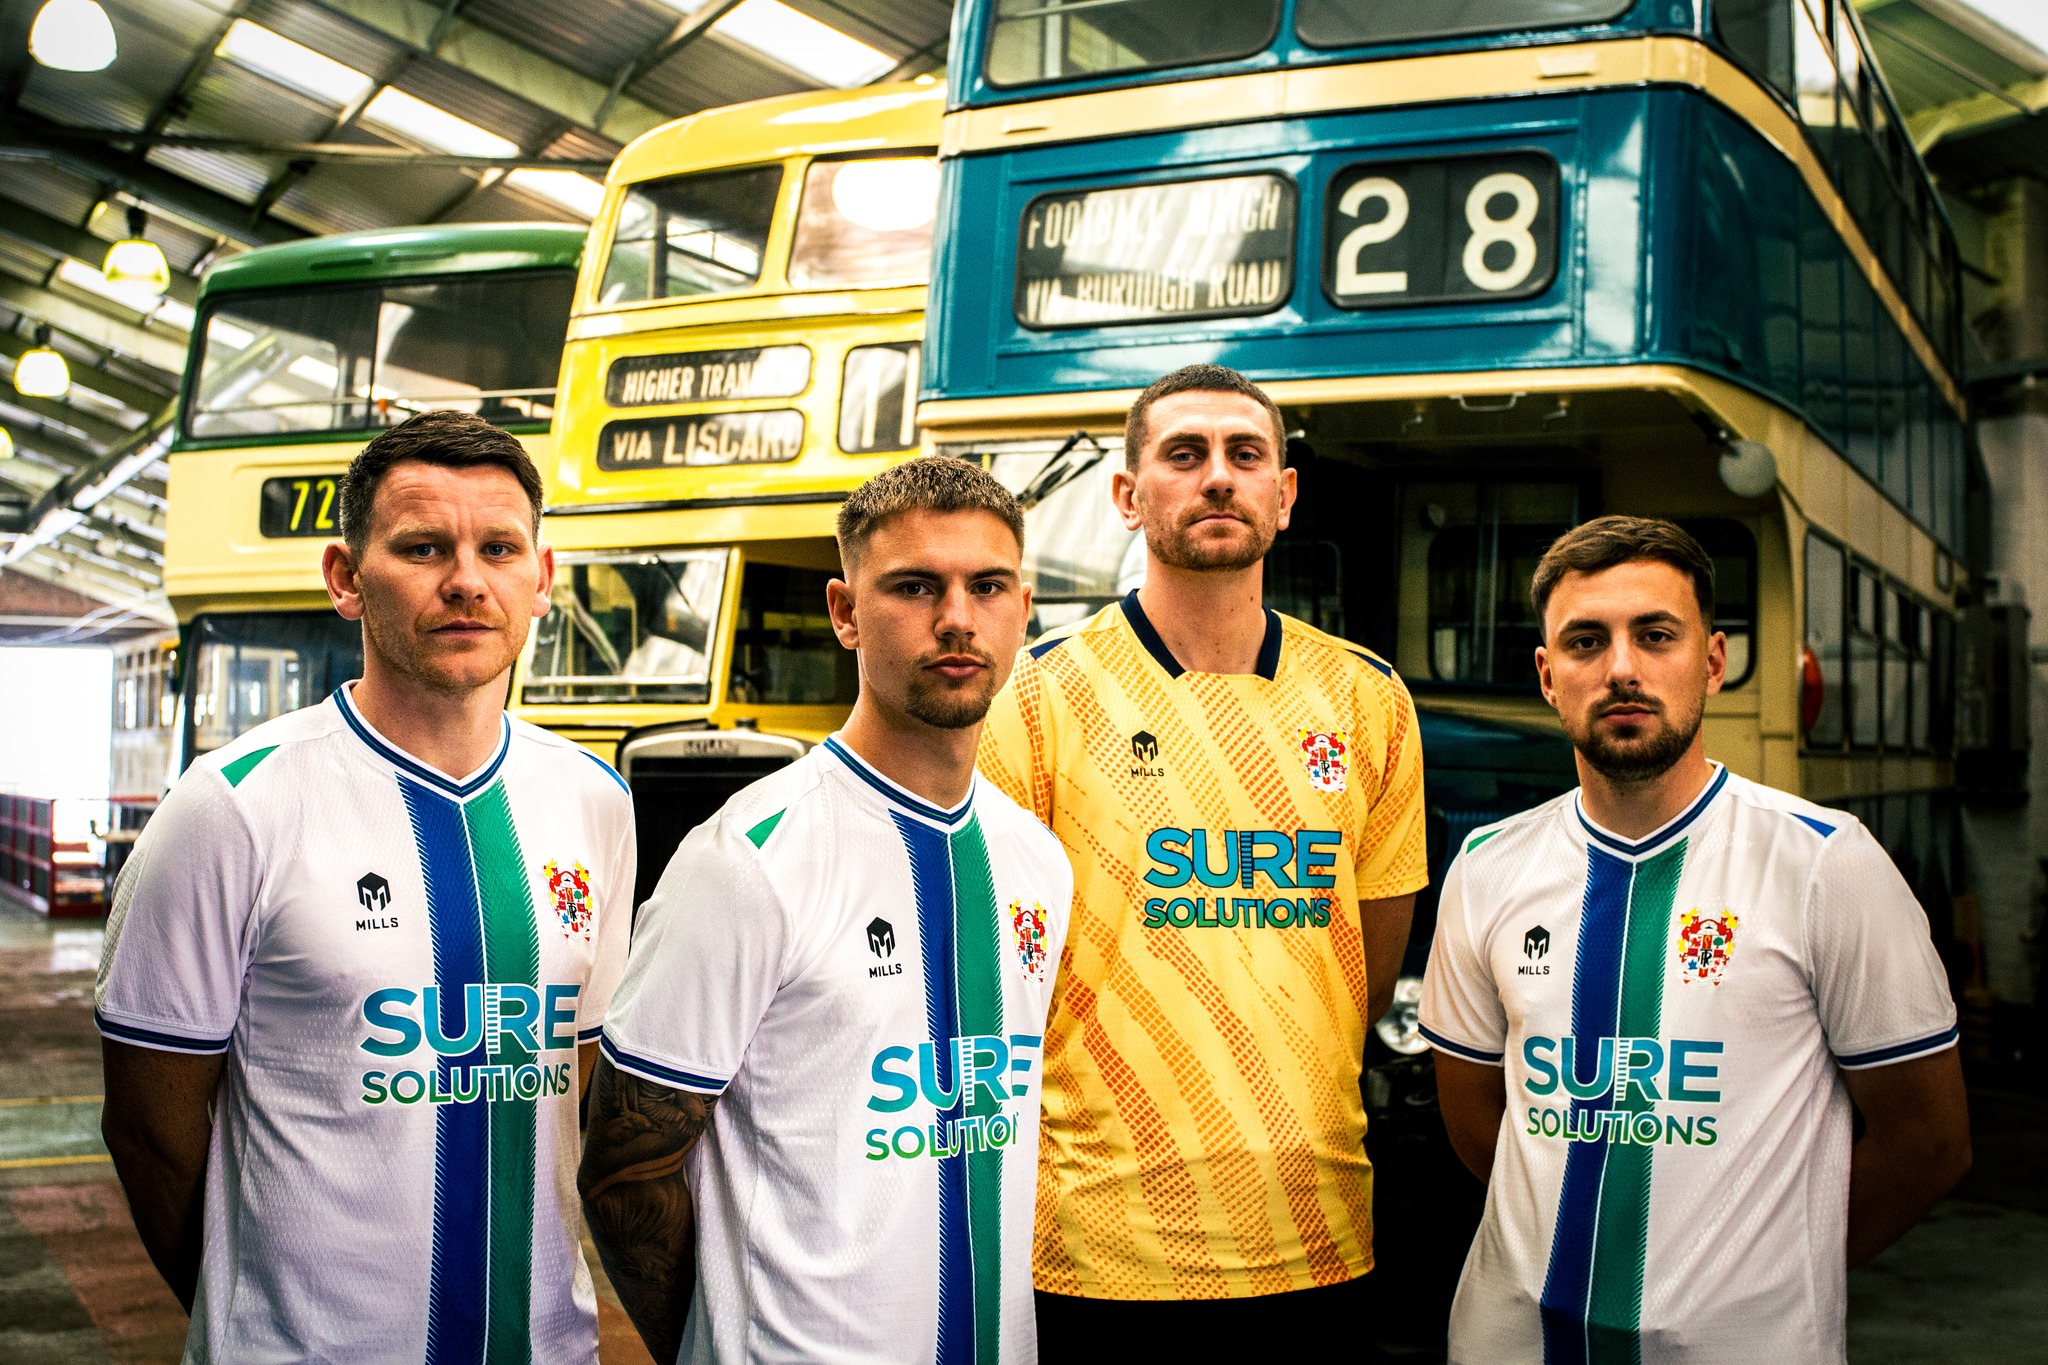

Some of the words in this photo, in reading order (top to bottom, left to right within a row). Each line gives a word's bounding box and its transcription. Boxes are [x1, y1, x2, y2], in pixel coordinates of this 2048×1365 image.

[1336, 172, 1539, 296] 28
[1027, 279, 1064, 324] VIA
[1203, 261, 1281, 309] ROAD
[622, 365, 696, 404] HIGHER
[613, 431, 652, 462] VIA
[662, 421, 799, 465] LISCARD
[289, 479, 336, 531] 72
[1131, 767, 1165, 777] MILLS
[1143, 827, 1342, 889] SURE
[356, 917, 399, 931] MILLS
[1143, 897, 1331, 929] SOLUTIONS
[869, 963, 902, 978] MILLS
[1517, 965, 1550, 975] MILLS
[358, 983, 582, 1057] SURE
[361, 1062, 571, 1105] SOLUTIONS
[866, 1034, 1043, 1113] SURE
[1523, 1035, 1724, 1103] SURE
[1526, 1107, 1719, 1147] SOLUTIONS
